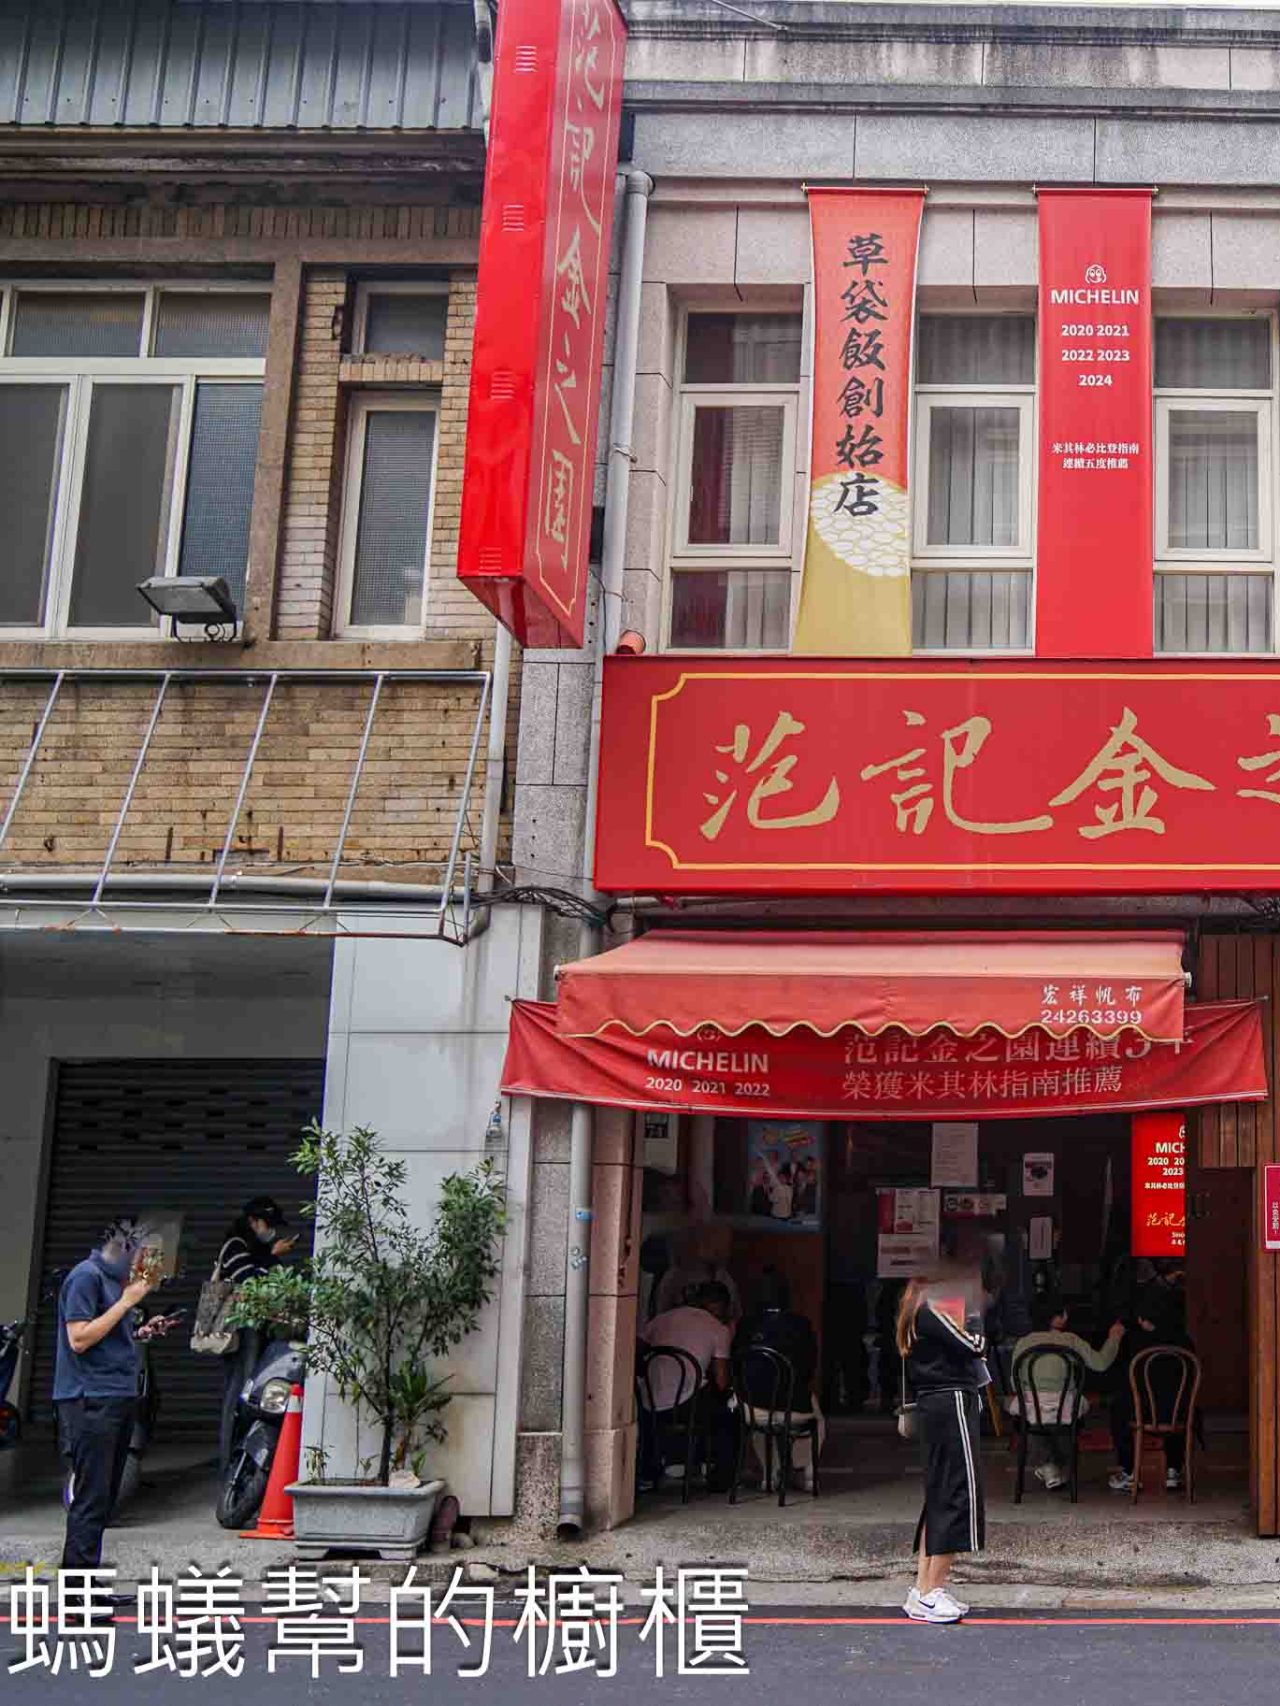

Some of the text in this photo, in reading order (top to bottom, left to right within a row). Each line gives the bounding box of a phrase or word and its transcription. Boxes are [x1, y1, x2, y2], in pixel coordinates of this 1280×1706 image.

[1050, 288, 1139, 305] MICHELIN
[1061, 324, 1130, 337] 2020 2021
[1061, 349, 1130, 362] 2022 2023
[833, 232, 890, 518] 草袋飯創始店
[1078, 374, 1112, 387] 2024
[1052, 442, 1139, 455] 米其林必比登指南
[1041, 984, 1143, 1008] 宏祥帆布
[1041, 1009, 1143, 1025] 24263399
[646, 1048, 769, 1073] MICHELIN
[645, 1076, 771, 1097] 2020 2021 2022
[842, 1065, 1123, 1101] 榮獲米其林指南推薦
[1147, 1157, 1169, 1166] 2020
[1162, 1168, 1184, 1176] 2023
